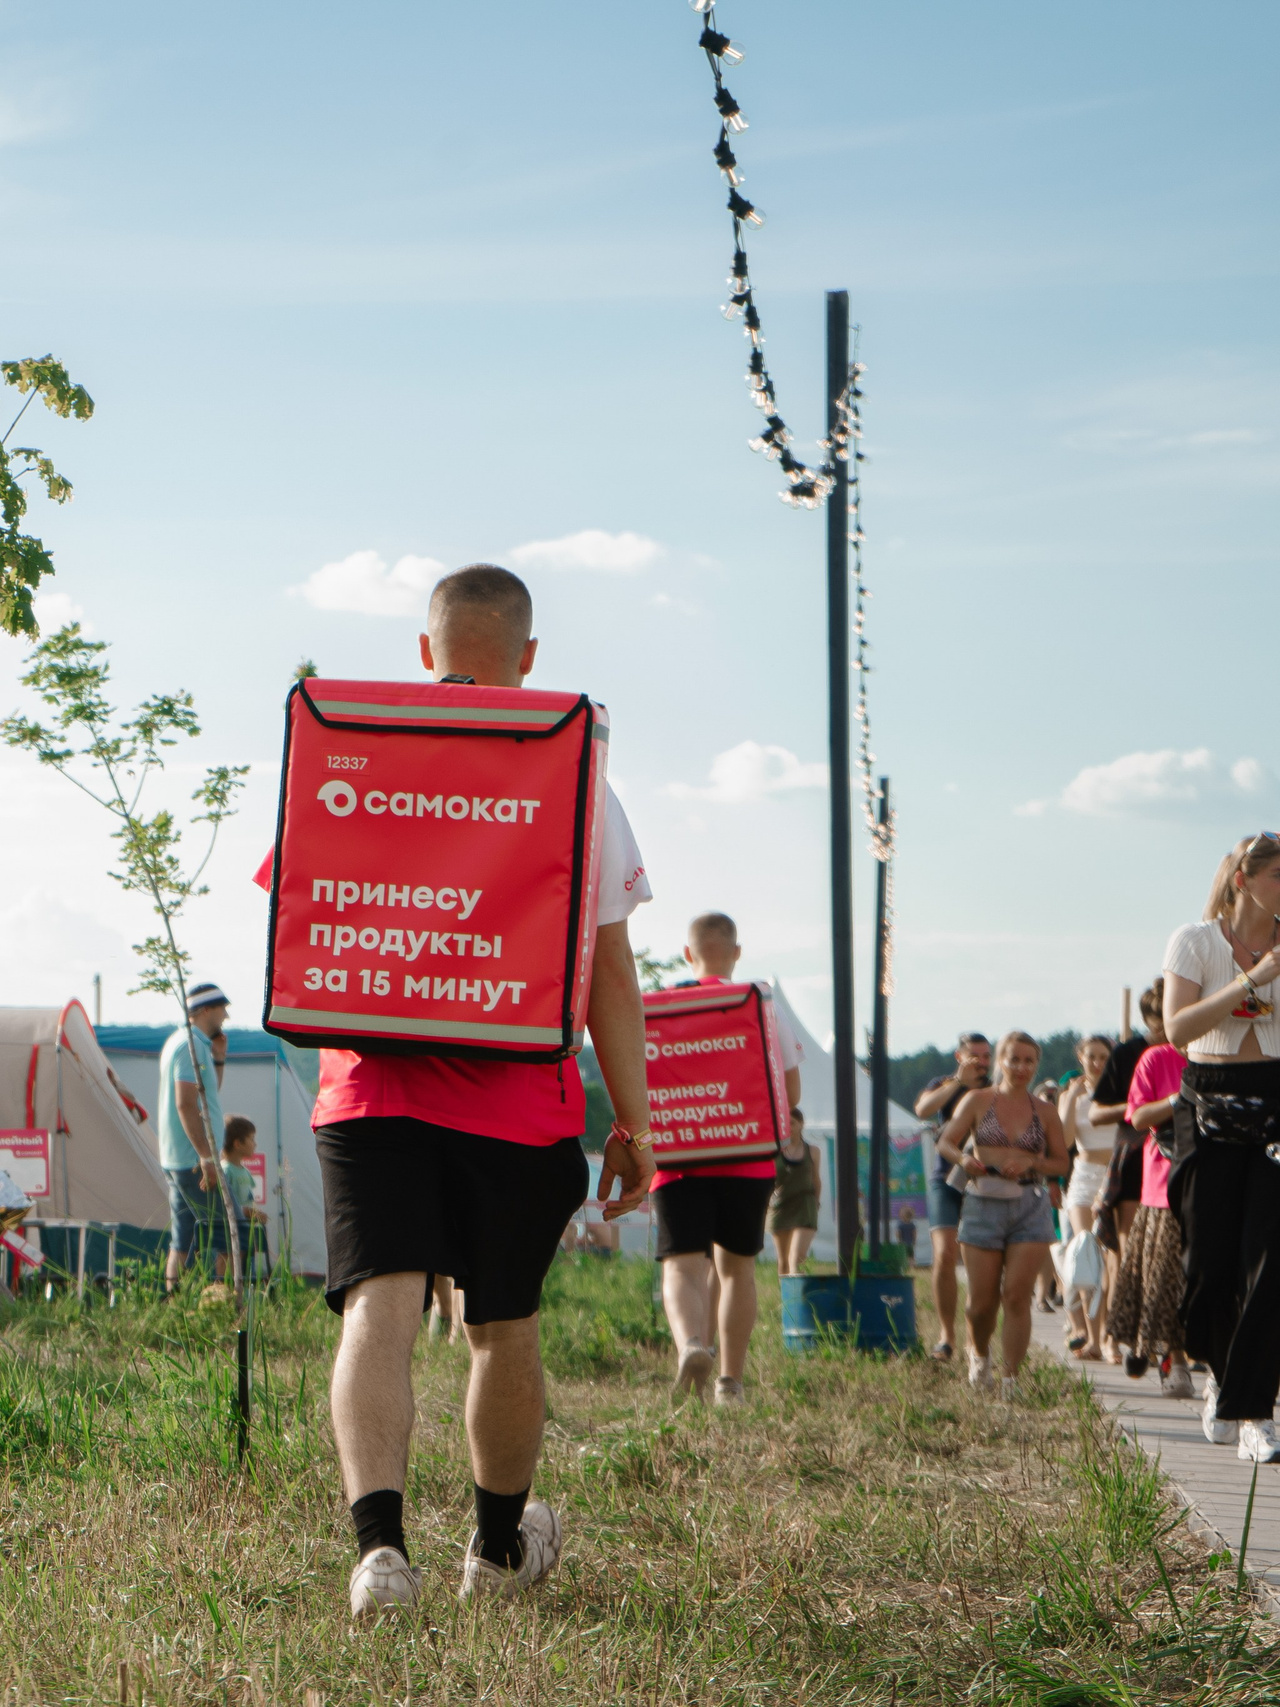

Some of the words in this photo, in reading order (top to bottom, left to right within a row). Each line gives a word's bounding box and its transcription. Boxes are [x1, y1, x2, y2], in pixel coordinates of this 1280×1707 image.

[326, 755, 368, 770] 12337
[364, 790, 541, 824] самокат
[312, 879, 483, 920] принесу
[309, 923, 502, 961] продукты
[303, 967, 348, 993] за
[358, 969, 391, 996] 15
[404, 975, 527, 1012] минут
[661, 1035, 747, 1057] самокат
[647, 1082, 728, 1105] принесу
[650, 1102, 744, 1126] продукты
[678, 1128, 695, 1142] 15
[699, 1122, 759, 1140] минут
